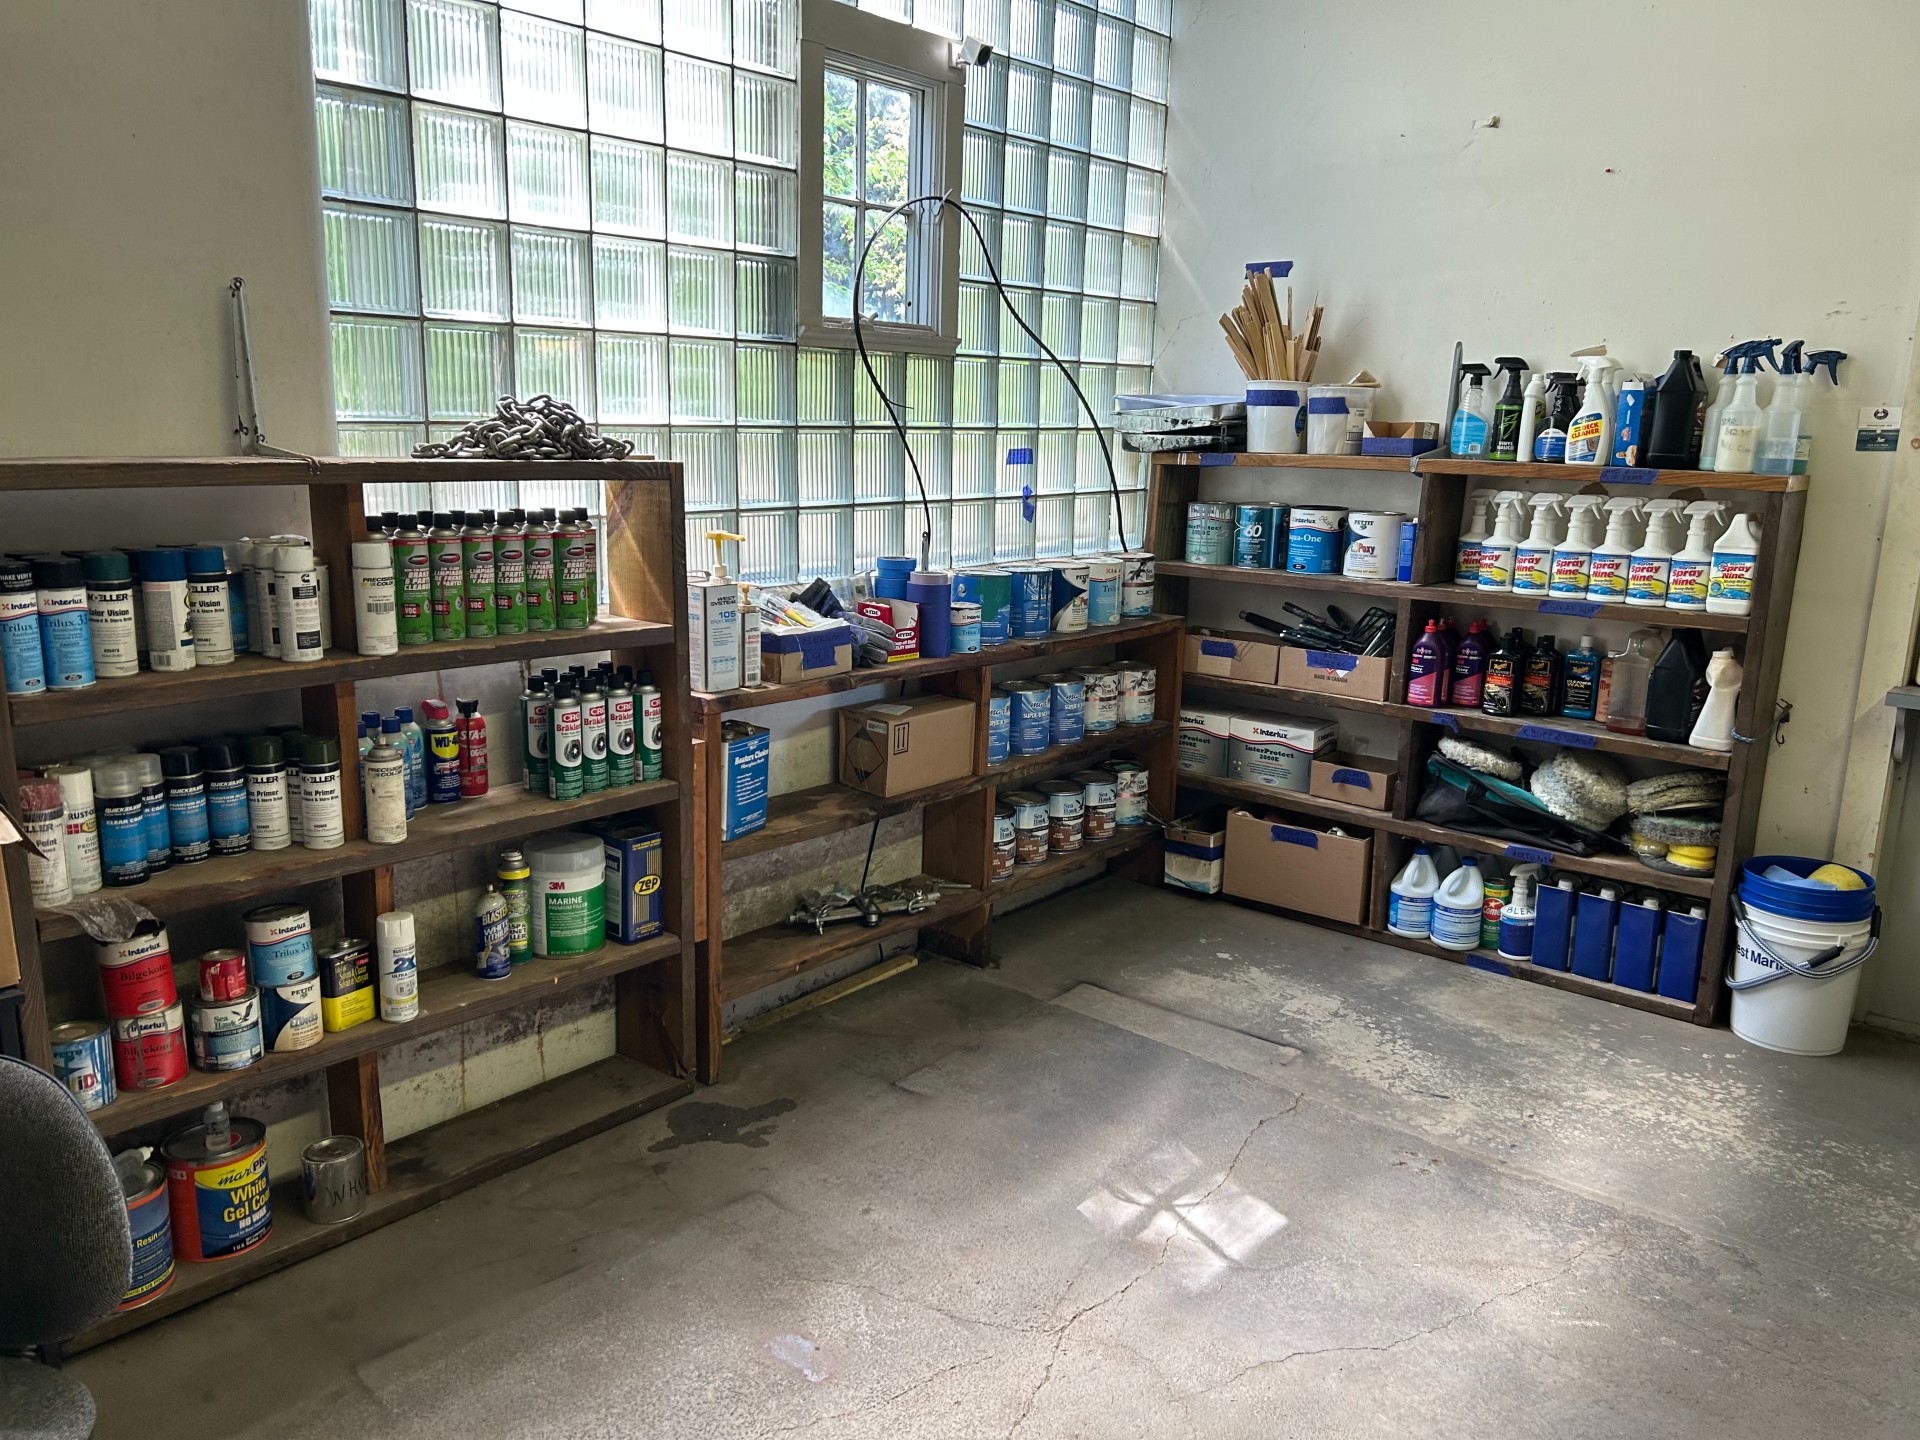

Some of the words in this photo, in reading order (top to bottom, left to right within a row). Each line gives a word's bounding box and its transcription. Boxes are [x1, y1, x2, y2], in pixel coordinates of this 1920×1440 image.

[1581, 422, 1599, 431] DECK
[1571, 428, 1600, 439] CLEANER
[1244, 524, 1262, 537] 60
[1556, 558, 1586, 568] Spray
[1592, 561, 1622, 572] Spray
[1555, 567, 1579, 576] Nine
[1631, 564, 1661, 574] Spray
[1672, 568, 1704, 578] Spray
[1722, 564, 1752, 573] Spray
[1592, 570, 1615, 578] Nine
[1630, 573, 1653, 582] Nine
[1721, 572, 1745, 580] Nine
[1671, 577, 1696, 586] Nine
[51, 598, 83, 606] Interlux
[199, 600, 221, 608] Vision
[107, 608, 130, 617] Vision
[718, 611, 737, 619] 105
[43, 617, 74, 628] Trilux
[2, 623, 33, 634] Trilux
[1314, 673, 1325, 681] MADE
[616, 702, 634, 711] CRC
[562, 713, 580, 722] CRC
[1259, 728, 1288, 739] Interlux
[1245, 744, 1295, 759] InterProtect
[1259, 754, 1280, 763] 2000E
[210, 778, 245, 788] QUICKSILVER
[170, 784, 204, 795] QUICKSILVER
[256, 789, 279, 797] Primer
[314, 788, 336, 797] Primer
[104, 803, 142, 814] QUICKSILVER
[549, 881, 565, 890] 3M
[548, 895, 584, 906] MARINE
[548, 903, 573, 911] PREMIUM
[1482, 904, 1501, 916] Come
[279, 921, 307, 935] Interlux
[127, 943, 161, 957] Interlux
[273, 949, 300, 960] Trilux
[119, 963, 167, 983] Bilgekote
[213, 1015, 229, 1023] Sea
[230, 1177, 267, 1205] White
[223, 1200, 250, 1223] Gel
[239, 1216, 252, 1229] NO
[251, 1205, 267, 1222] WAX
[136, 1232, 158, 1249] Resin
